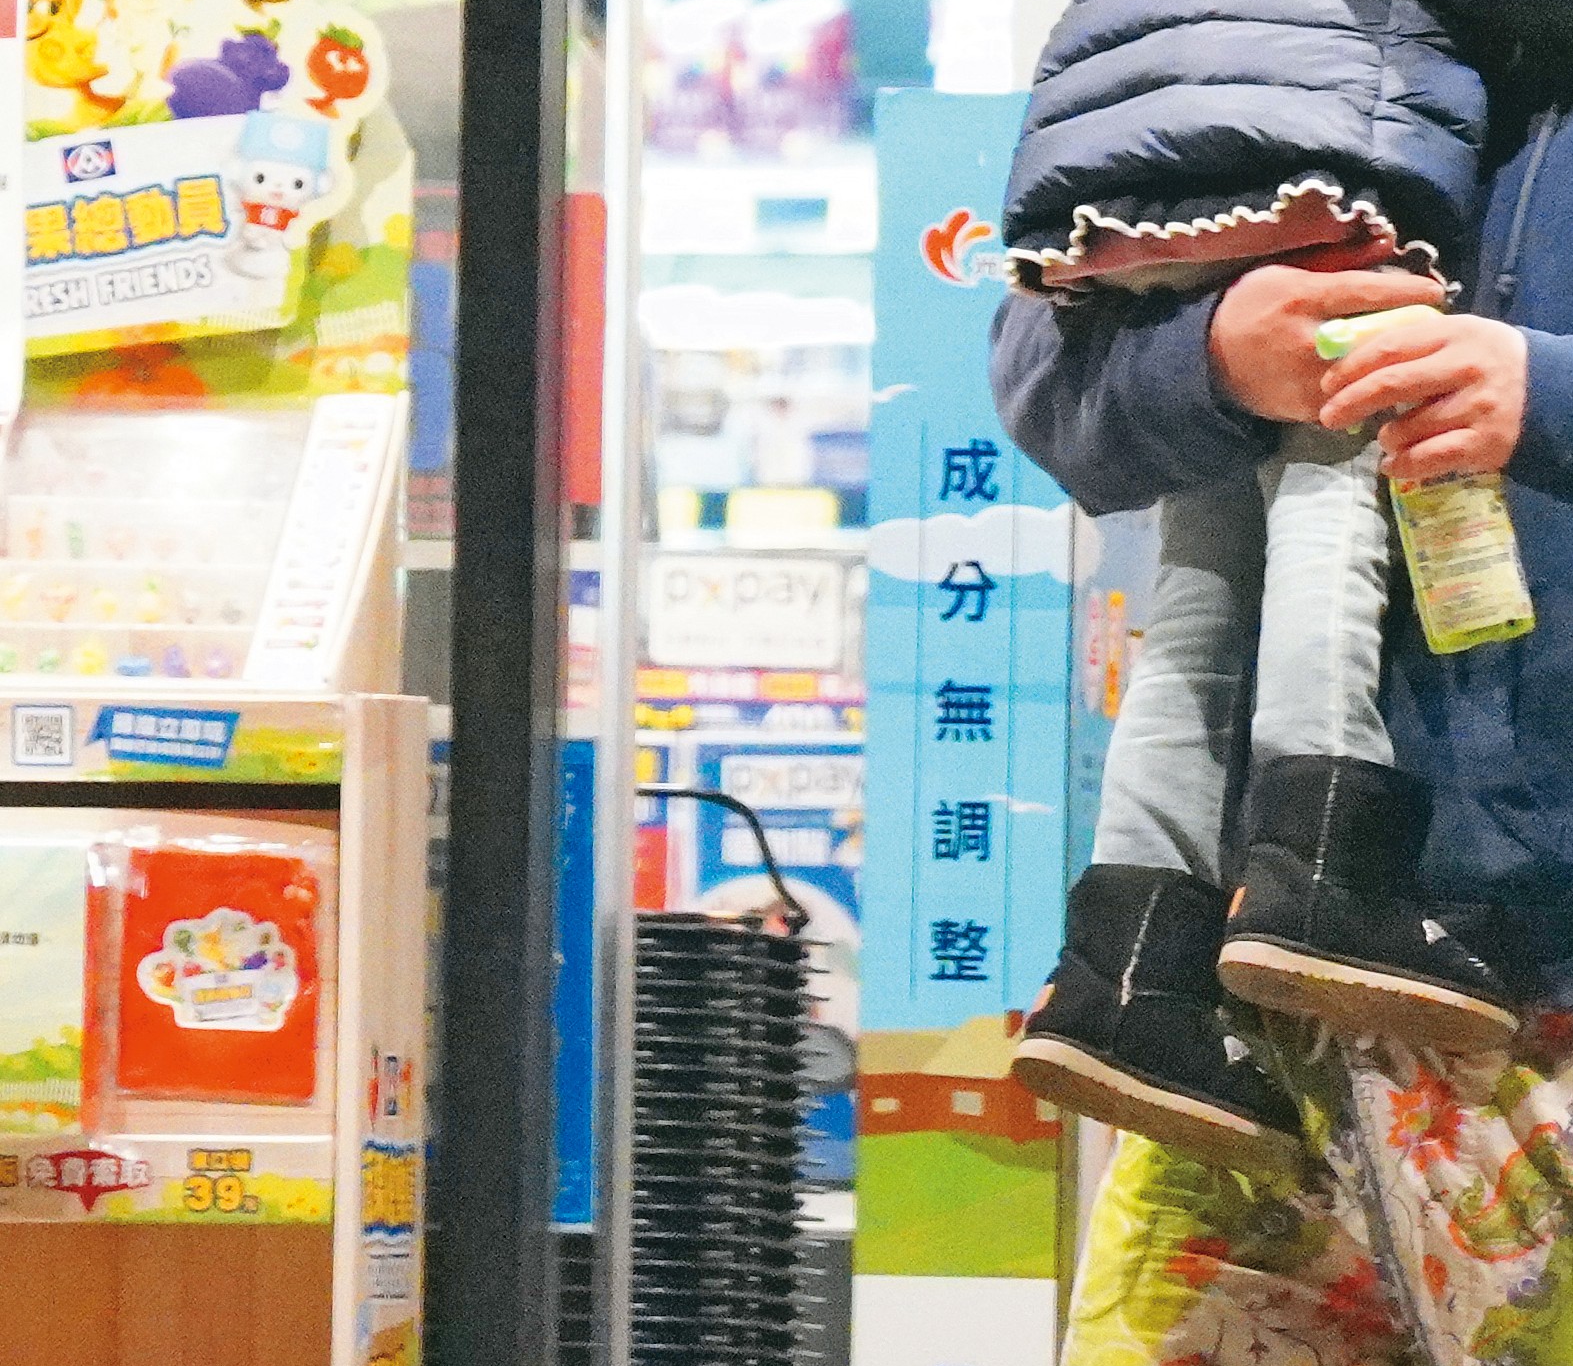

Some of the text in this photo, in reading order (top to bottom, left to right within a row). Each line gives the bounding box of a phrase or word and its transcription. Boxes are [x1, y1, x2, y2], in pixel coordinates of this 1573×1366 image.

[96, 255, 212, 305] FRIENDS
[930, 437, 1001, 983] 成分無調整
